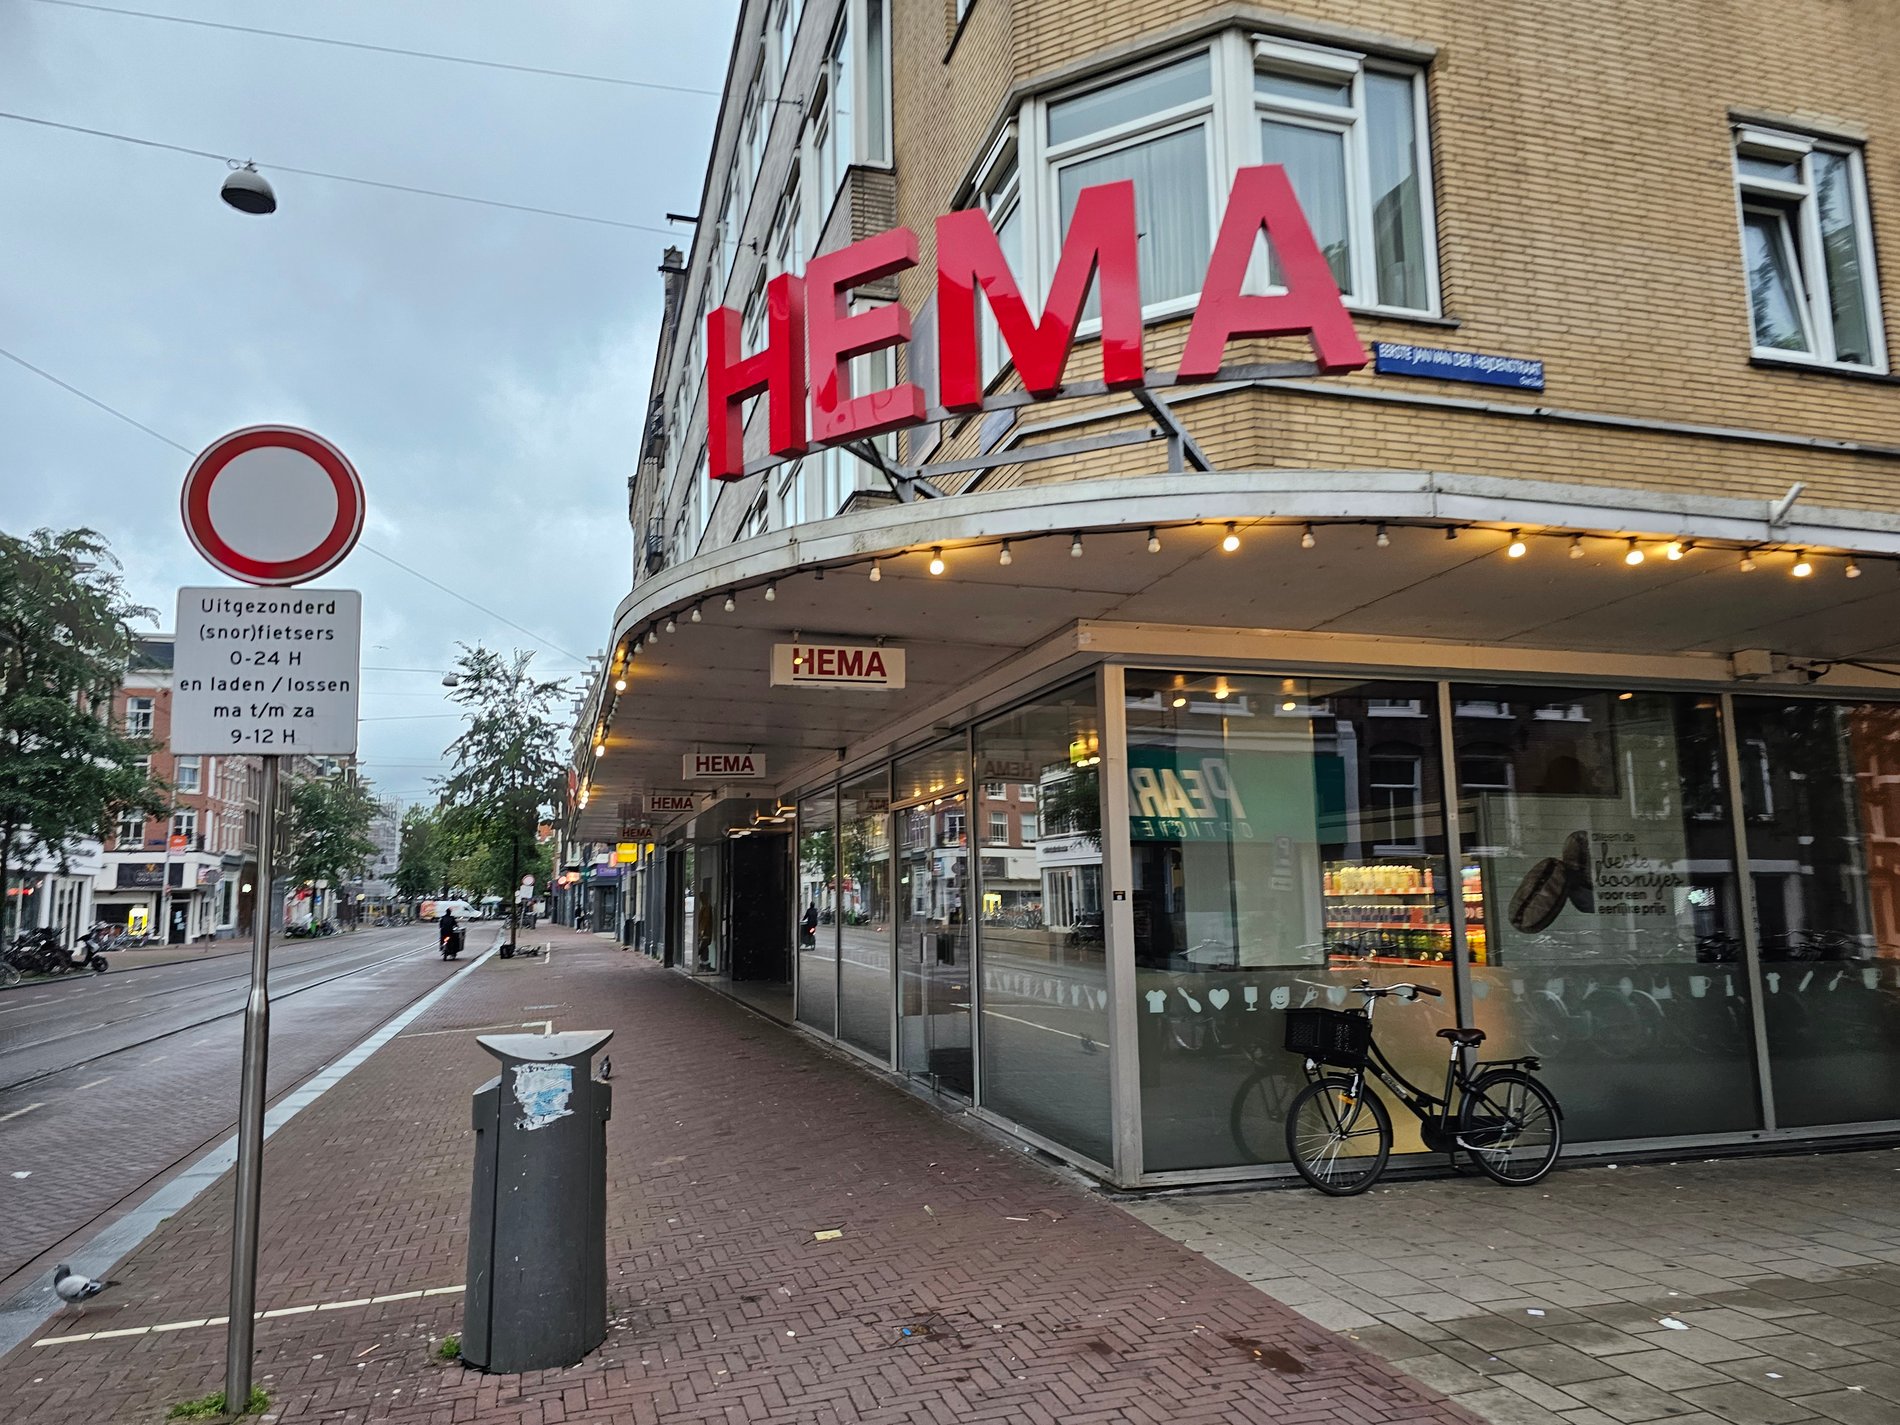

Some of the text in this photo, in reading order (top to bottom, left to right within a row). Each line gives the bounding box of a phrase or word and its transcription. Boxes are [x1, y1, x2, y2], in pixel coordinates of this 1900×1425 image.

[708, 163, 1368, 482] HEMA
[201, 598, 336, 618] Uitgezonderd
[199, 624, 335, 642] (snor)fietsers
[230, 650, 302, 666] 0-24 H
[792, 648, 888, 678] HEMA
[180, 679, 202, 691] en
[210, 676, 265, 692] laden
[213, 702, 315, 719] ma t/m za
[230, 729, 296, 744] 9-12 H
[695, 755, 755, 773] HEMA
[651, 796, 694, 810] HEMA
[622, 828, 653, 838] HEMA
